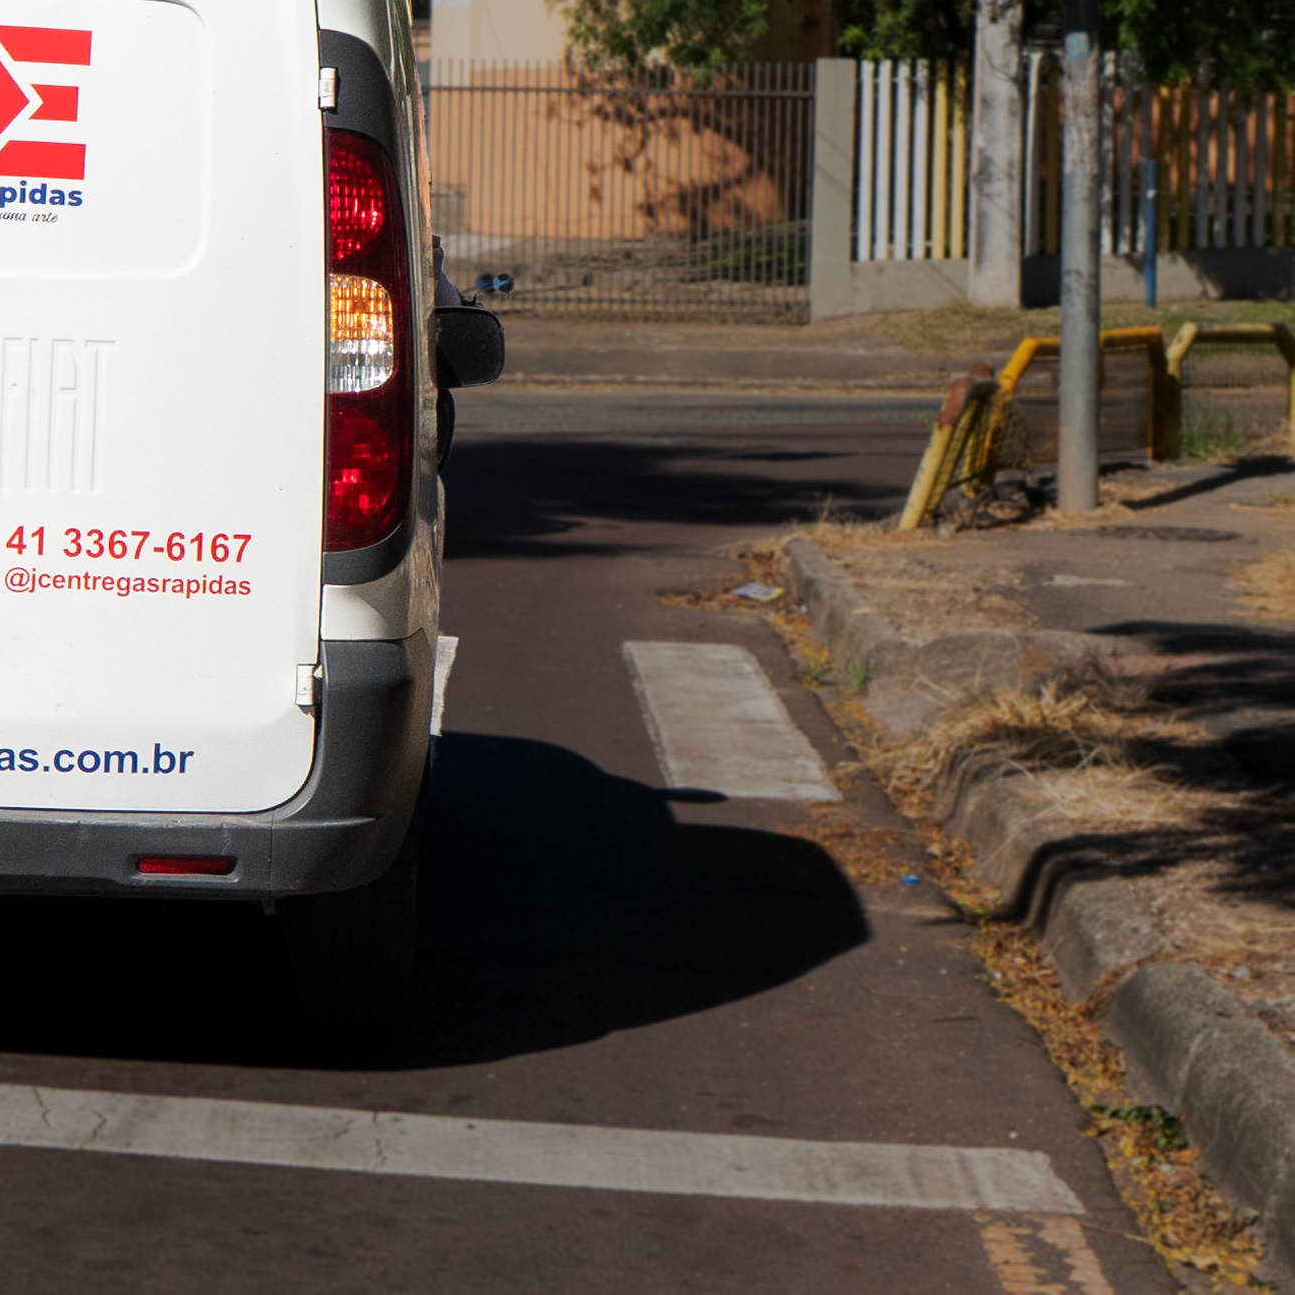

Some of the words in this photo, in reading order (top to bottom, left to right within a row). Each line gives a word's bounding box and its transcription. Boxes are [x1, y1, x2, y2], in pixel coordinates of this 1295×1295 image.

[31, 212, 59, 224] arte
[5, 525, 45, 556] 41
[62, 527, 253, 564] 3367-6167
[4, 566, 252, 600] @jcentregasrapidas
